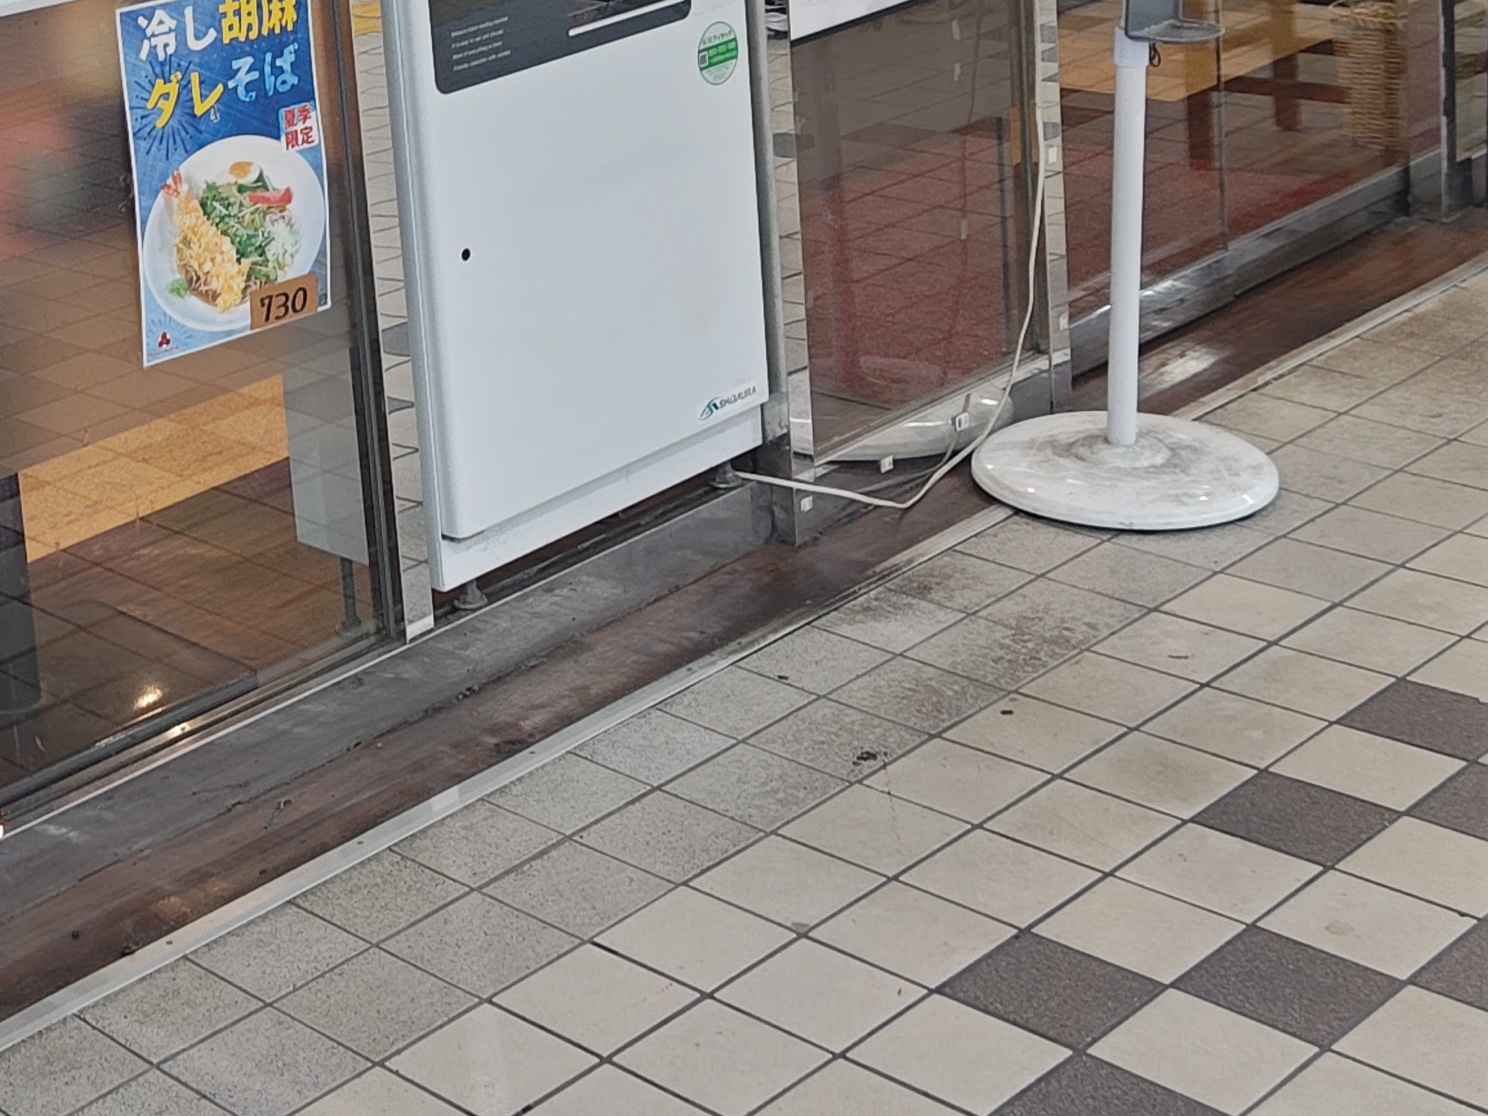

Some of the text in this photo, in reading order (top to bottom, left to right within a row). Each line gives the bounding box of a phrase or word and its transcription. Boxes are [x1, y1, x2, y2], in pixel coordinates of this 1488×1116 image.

[147, 42, 299, 129] ダレそば
[284, 103, 312, 127] 夏季
[285, 126, 315, 151] 限定
[260, 287, 308, 323] 730
